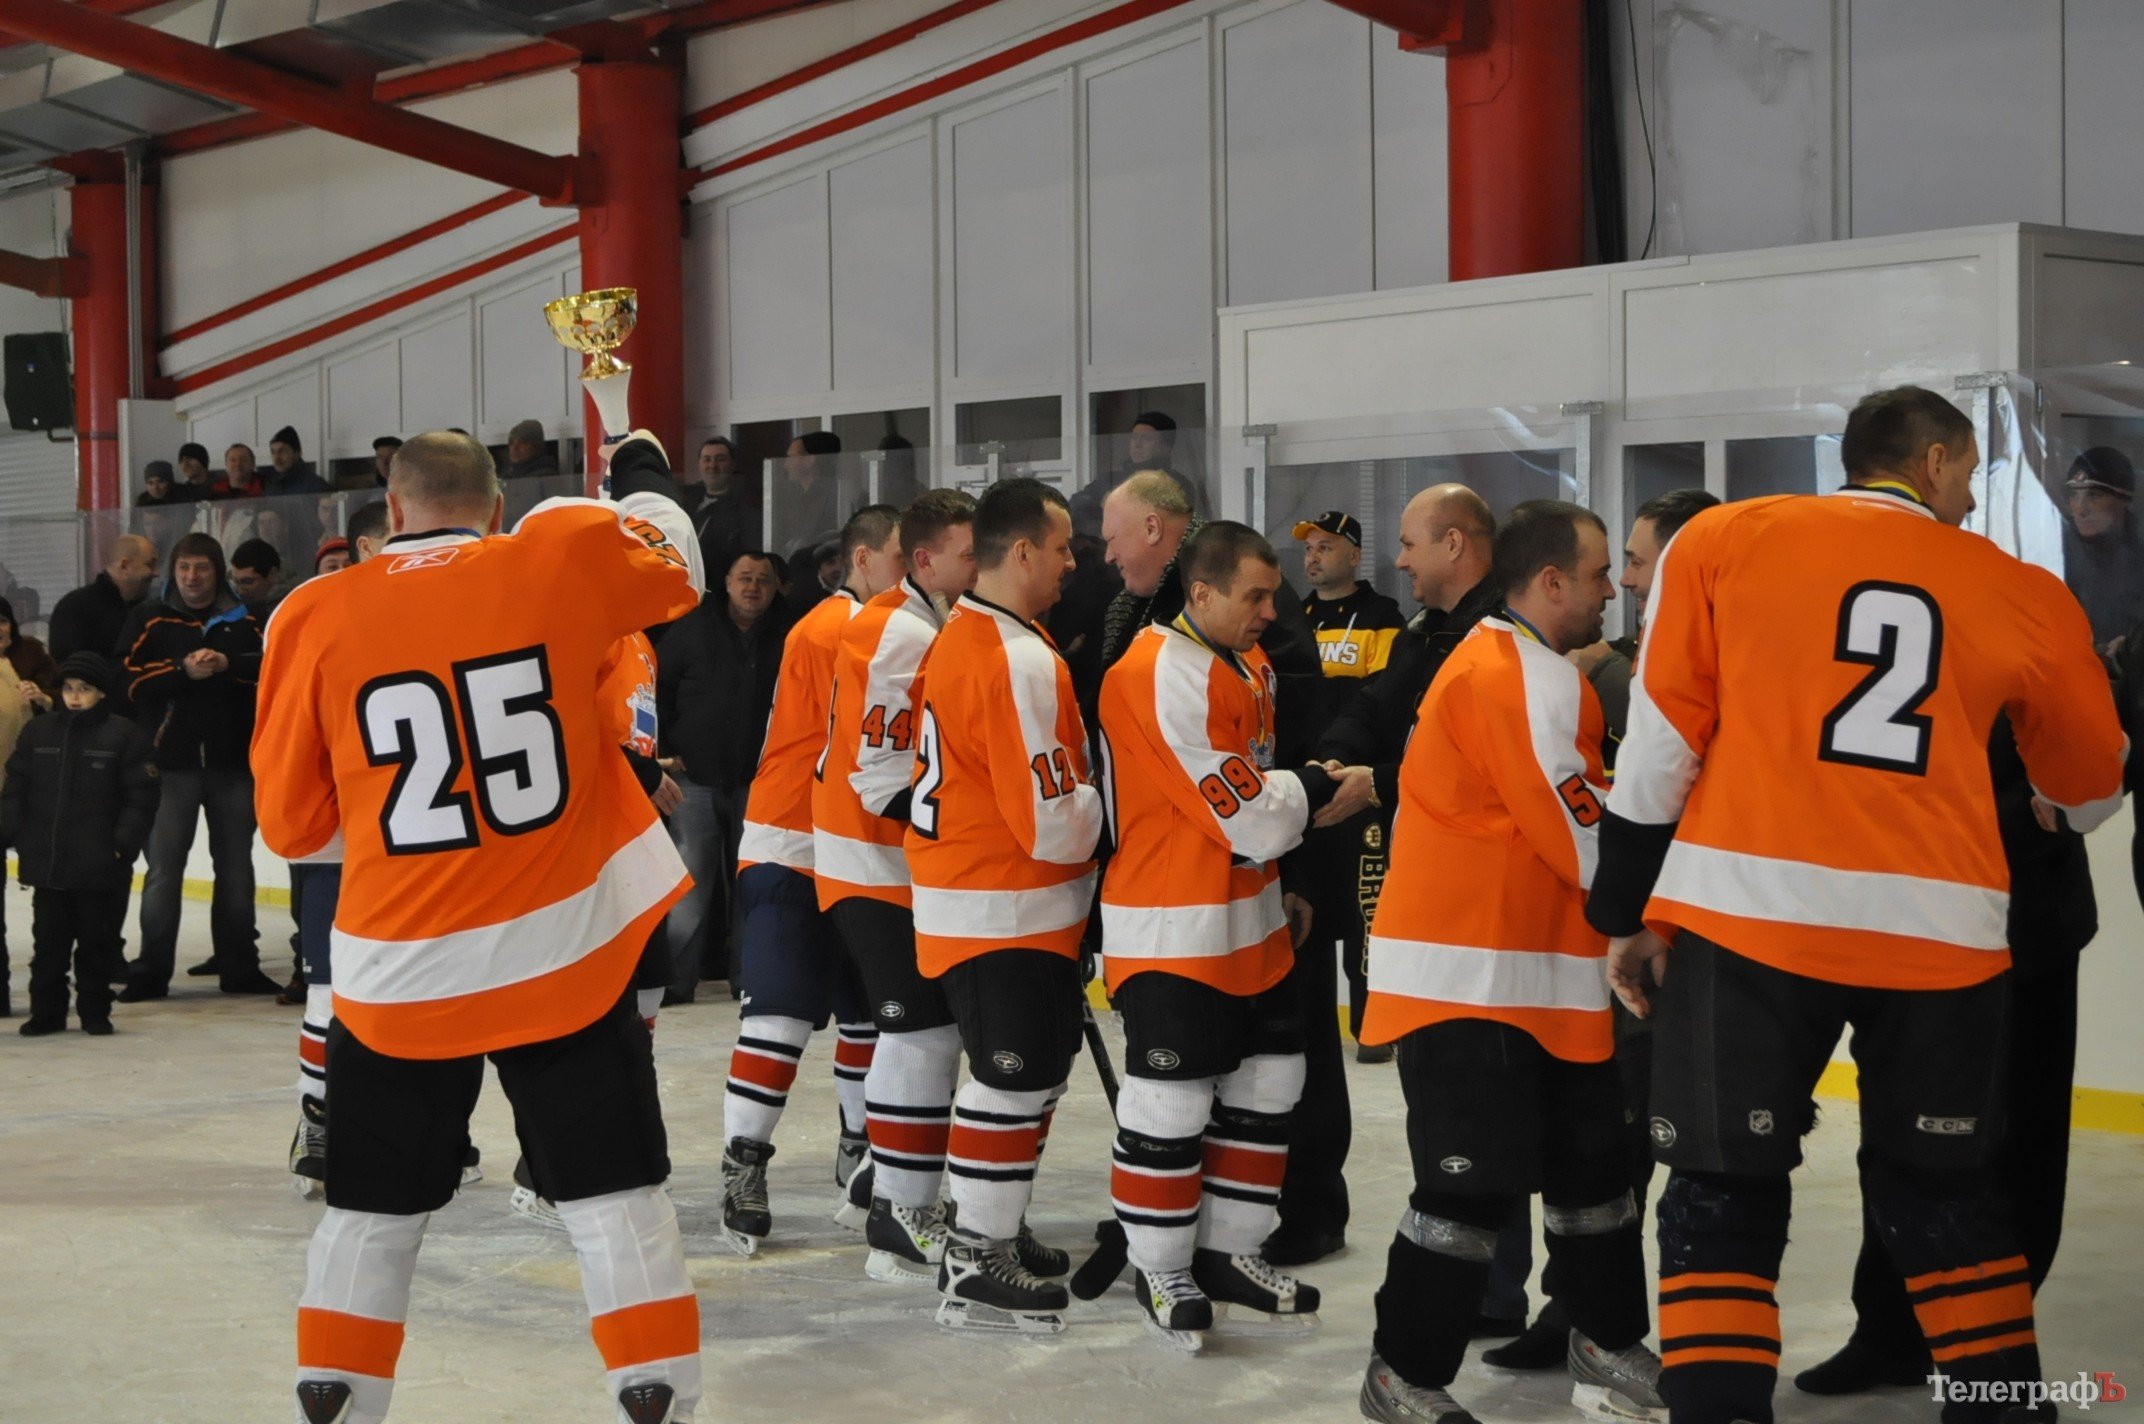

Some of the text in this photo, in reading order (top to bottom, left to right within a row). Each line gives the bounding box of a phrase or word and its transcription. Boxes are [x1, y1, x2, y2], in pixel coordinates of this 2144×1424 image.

[1817, 579, 1944, 777] 2
[355, 643, 570, 856] 25
[861, 704, 913, 751] 44
[1031, 747, 1077, 801] 12
[1198, 755, 1263, 819] 99
